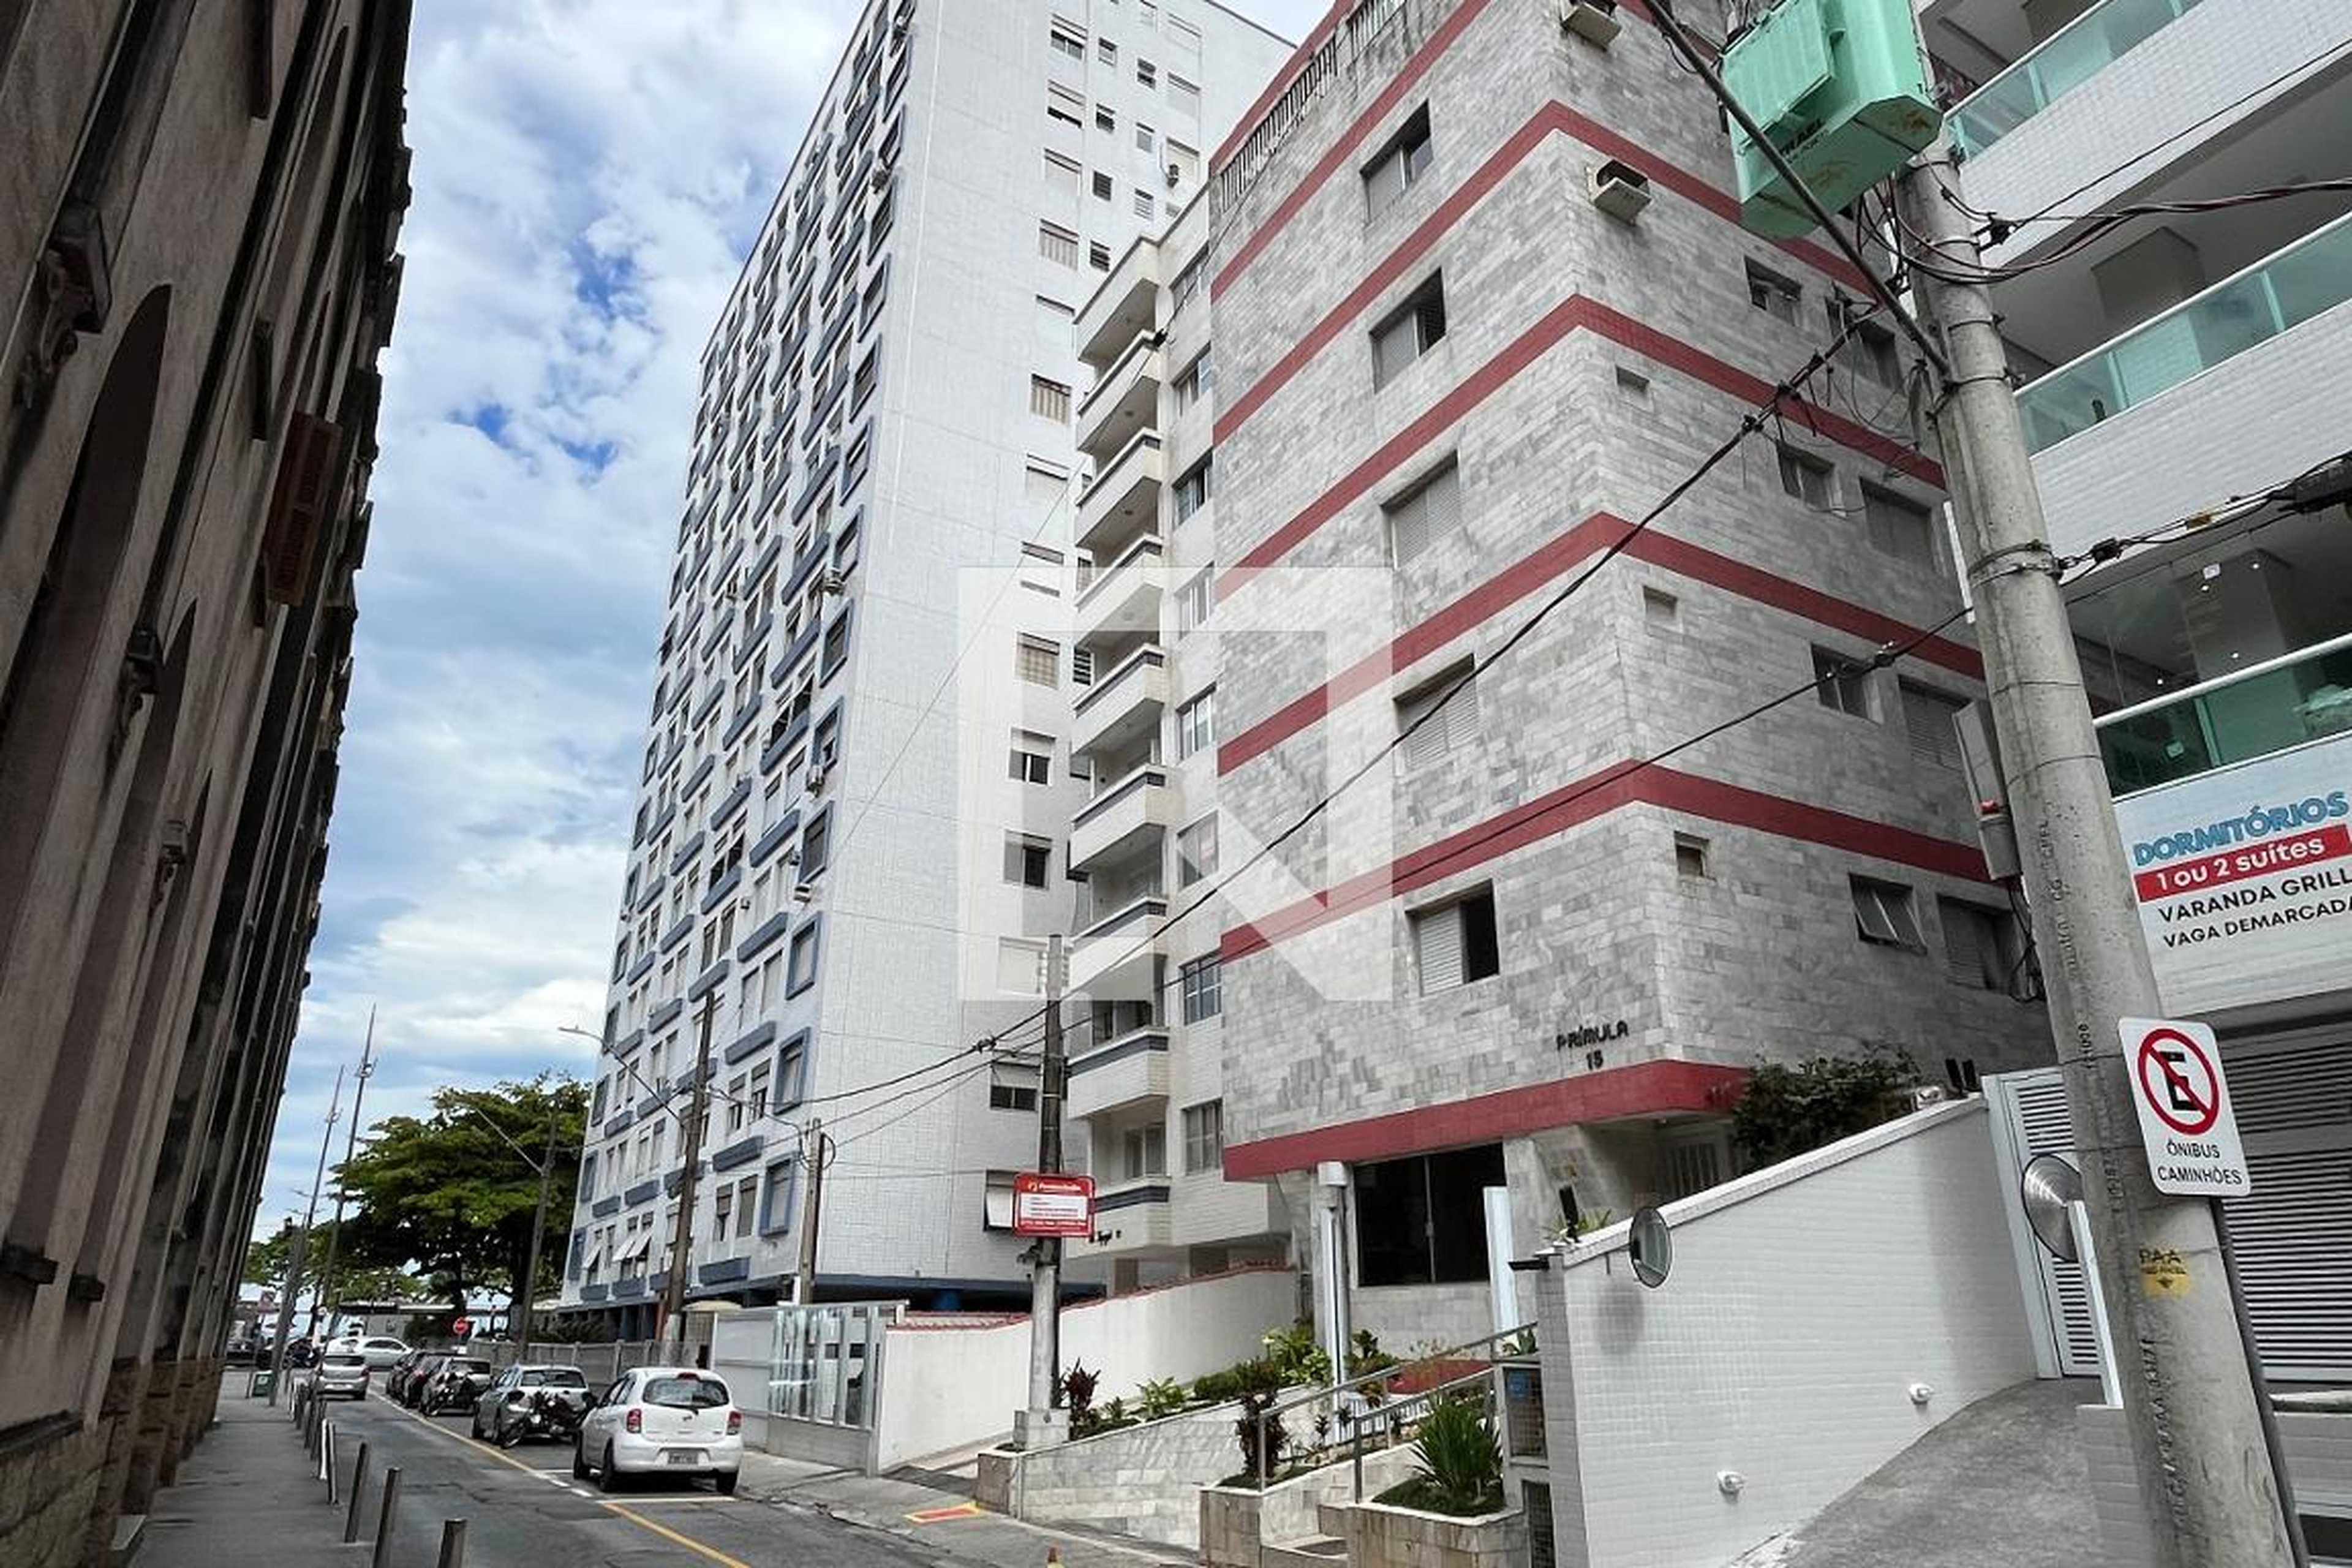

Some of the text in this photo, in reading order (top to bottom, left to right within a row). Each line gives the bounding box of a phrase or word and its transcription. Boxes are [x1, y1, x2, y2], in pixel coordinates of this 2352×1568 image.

[2134, 791, 2349, 866] DORMITÓRIOS
[2157, 872, 2168, 891] 1
[2174, 865, 2207, 886] ou
[2214, 859, 2230, 877] 2
[2158, 867, 2352, 923] VARANDA GRILL
[2163, 895, 2352, 948] VAGA DEMARCAD
[2166, 1138, 2220, 1159] ÔNIBUS
[2157, 1165, 2242, 1185] CAMINHÕES
